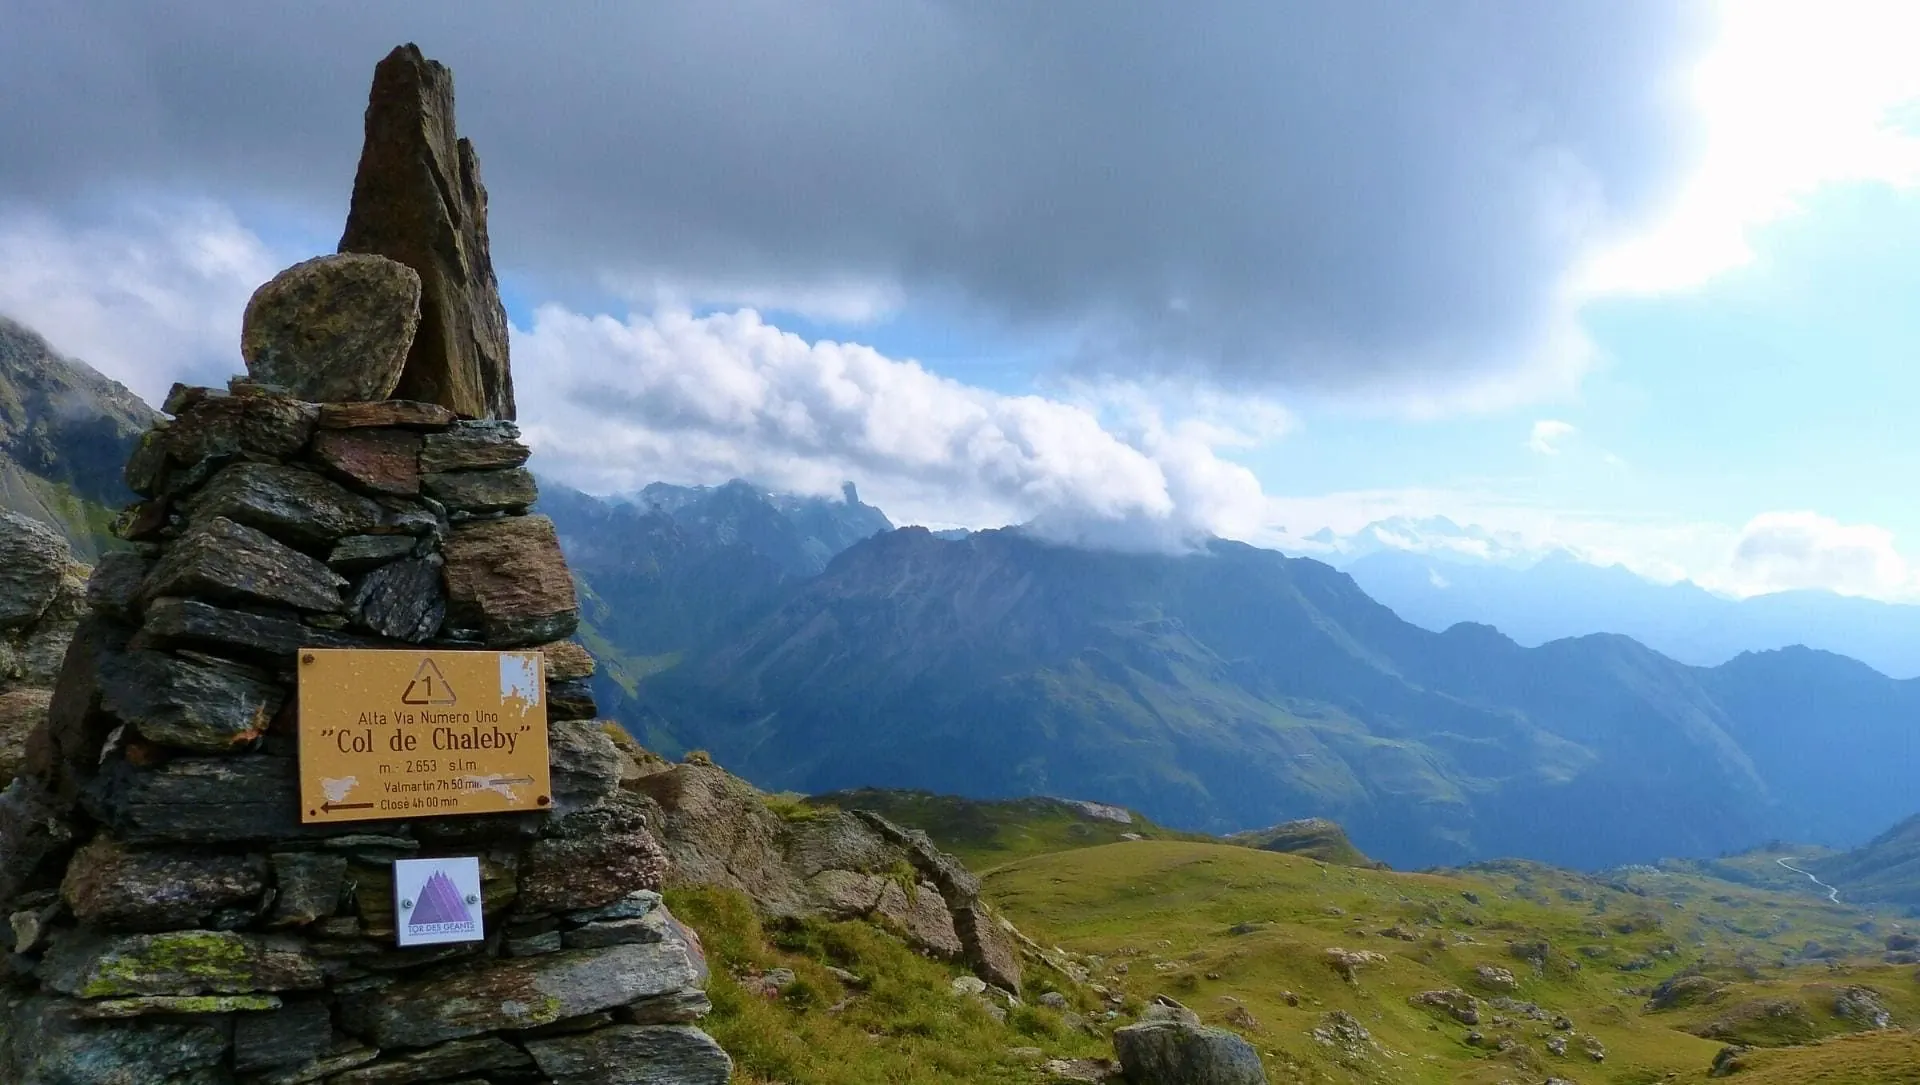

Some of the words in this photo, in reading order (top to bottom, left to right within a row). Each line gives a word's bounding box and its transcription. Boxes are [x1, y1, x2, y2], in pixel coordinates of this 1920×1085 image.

[422, 676, 431, 696] 1
[358, 711, 387, 725] Alta
[394, 711, 415, 725] Via
[421, 710, 470, 724] Numero
[475, 710, 498, 723] Uno
[389, 728, 417, 752] de
[384, 780, 435, 793] Valmartin
[436, 780, 449, 791] 7h
[451, 779, 463, 790] 50
[412, 799, 425, 810] 4h
[426, 797, 439, 809] 00
[440, 798, 458, 808] min
